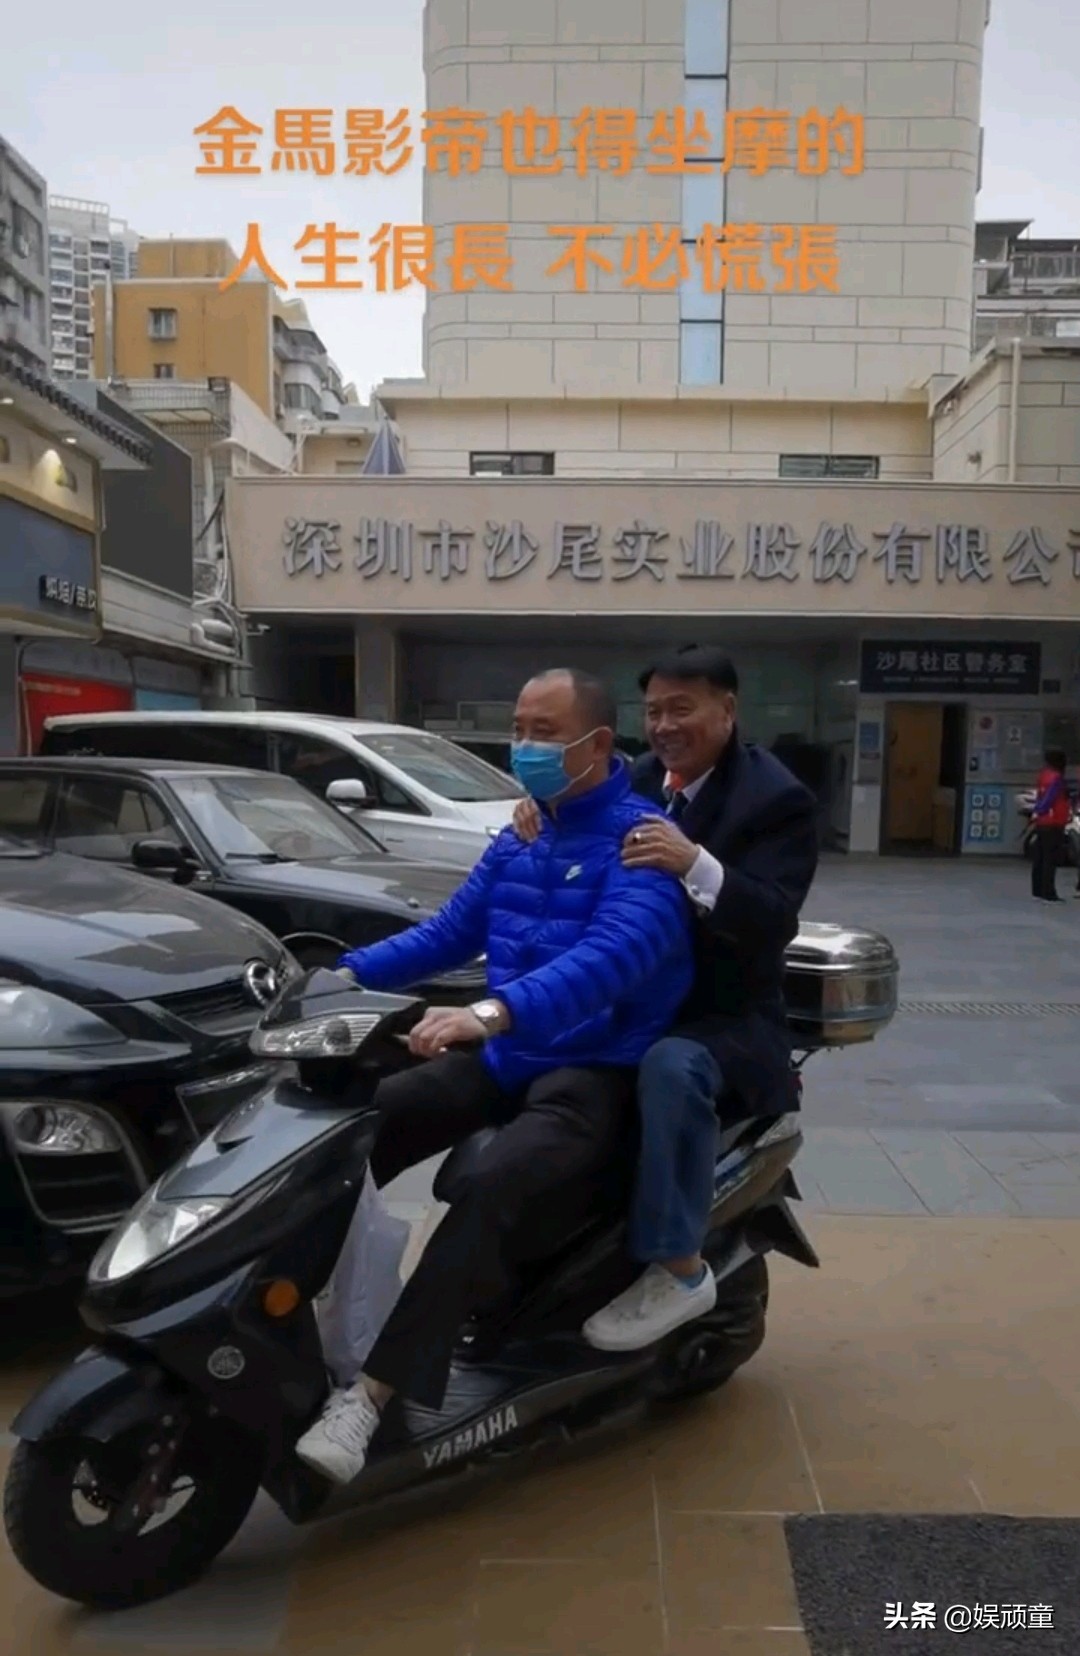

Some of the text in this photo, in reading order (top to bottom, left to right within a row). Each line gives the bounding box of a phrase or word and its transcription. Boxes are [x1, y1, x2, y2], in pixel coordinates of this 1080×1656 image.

[281, 516, 1080, 587] 深圳市沙尾实业股份有限公
[423, 1404, 518, 1469] YAMAHA
